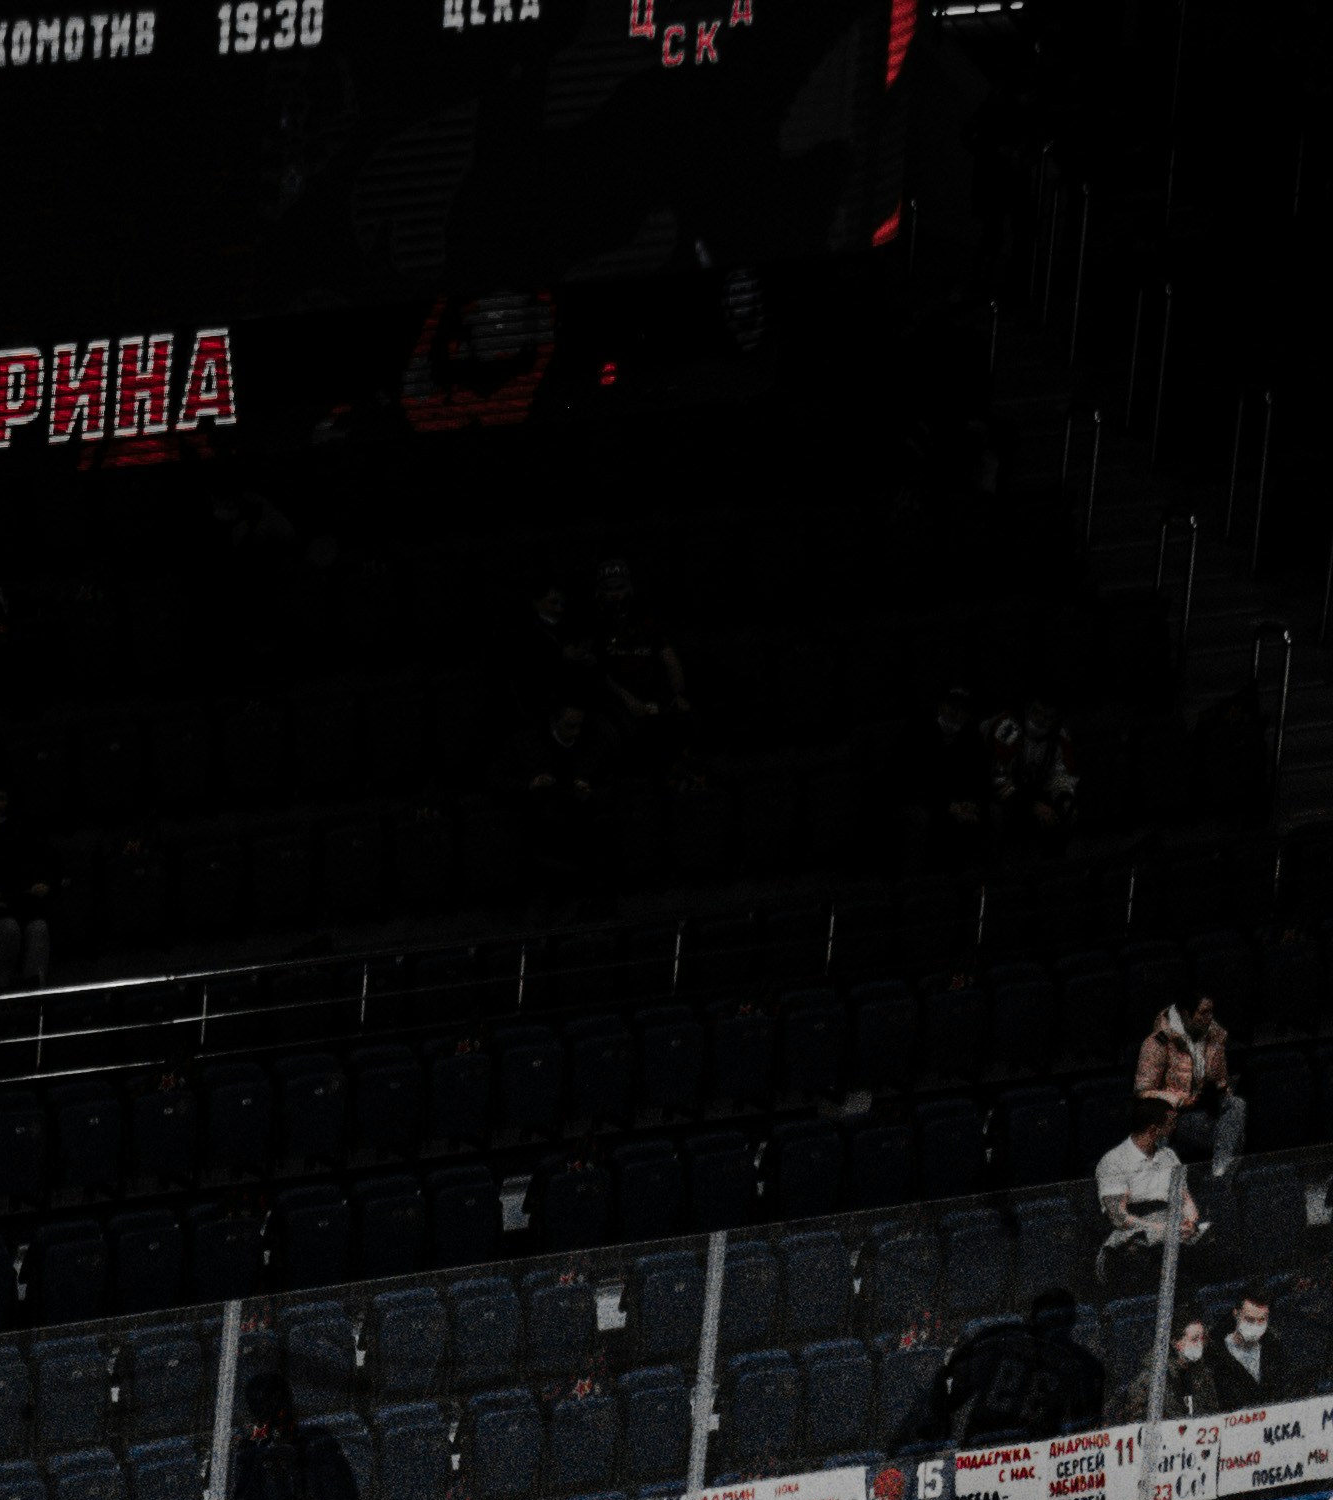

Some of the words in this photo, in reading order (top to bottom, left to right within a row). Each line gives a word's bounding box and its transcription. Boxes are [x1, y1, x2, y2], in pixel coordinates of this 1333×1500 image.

[217, 0, 325, 55] 19:30
[1049, 1432, 1111, 1459] АНДРОНОВ
[1056, 1451, 1106, 1478] СЕРГЕЙ
[1252, 1462, 1304, 1487] ПОБЕДА
[916, 1459, 945, 1500] 15
[1049, 1469, 1106, 1497] ЗАБИВАЙ
